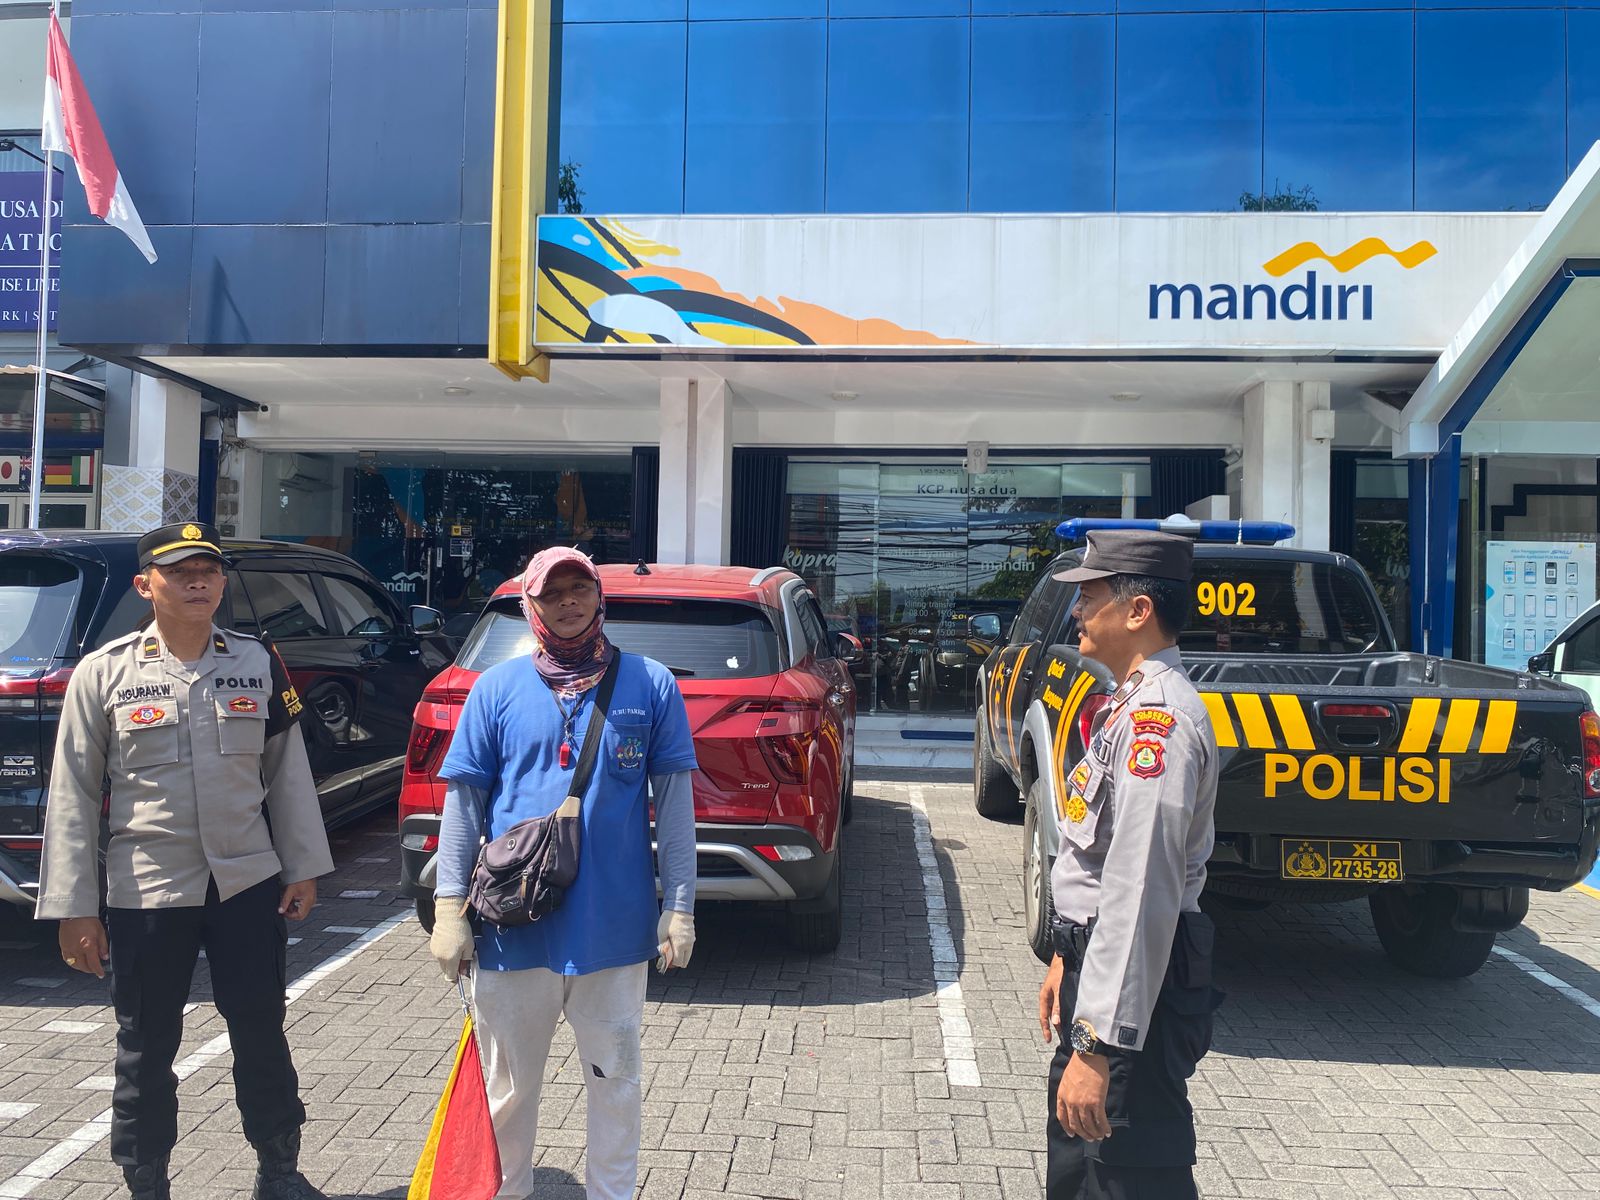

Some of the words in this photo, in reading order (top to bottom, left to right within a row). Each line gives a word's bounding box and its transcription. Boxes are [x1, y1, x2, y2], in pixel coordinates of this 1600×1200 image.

[1149, 270, 1373, 321] mandiri
[917, 484, 944, 495] KCP
[949, 487, 986, 495] nusa
[989, 484, 1017, 495] dua
[782, 545, 838, 573] kopra
[980, 559, 1035, 572] mandiri
[380, 579, 415, 593] ndiri
[1197, 581, 1256, 616] 902
[117, 683, 170, 701] NGURAH.W
[215, 677, 263, 689] POLRI
[1264, 753, 1451, 803] POLISI
[1352, 843, 1377, 857] XI
[1332, 859, 1398, 879] 2735-28
